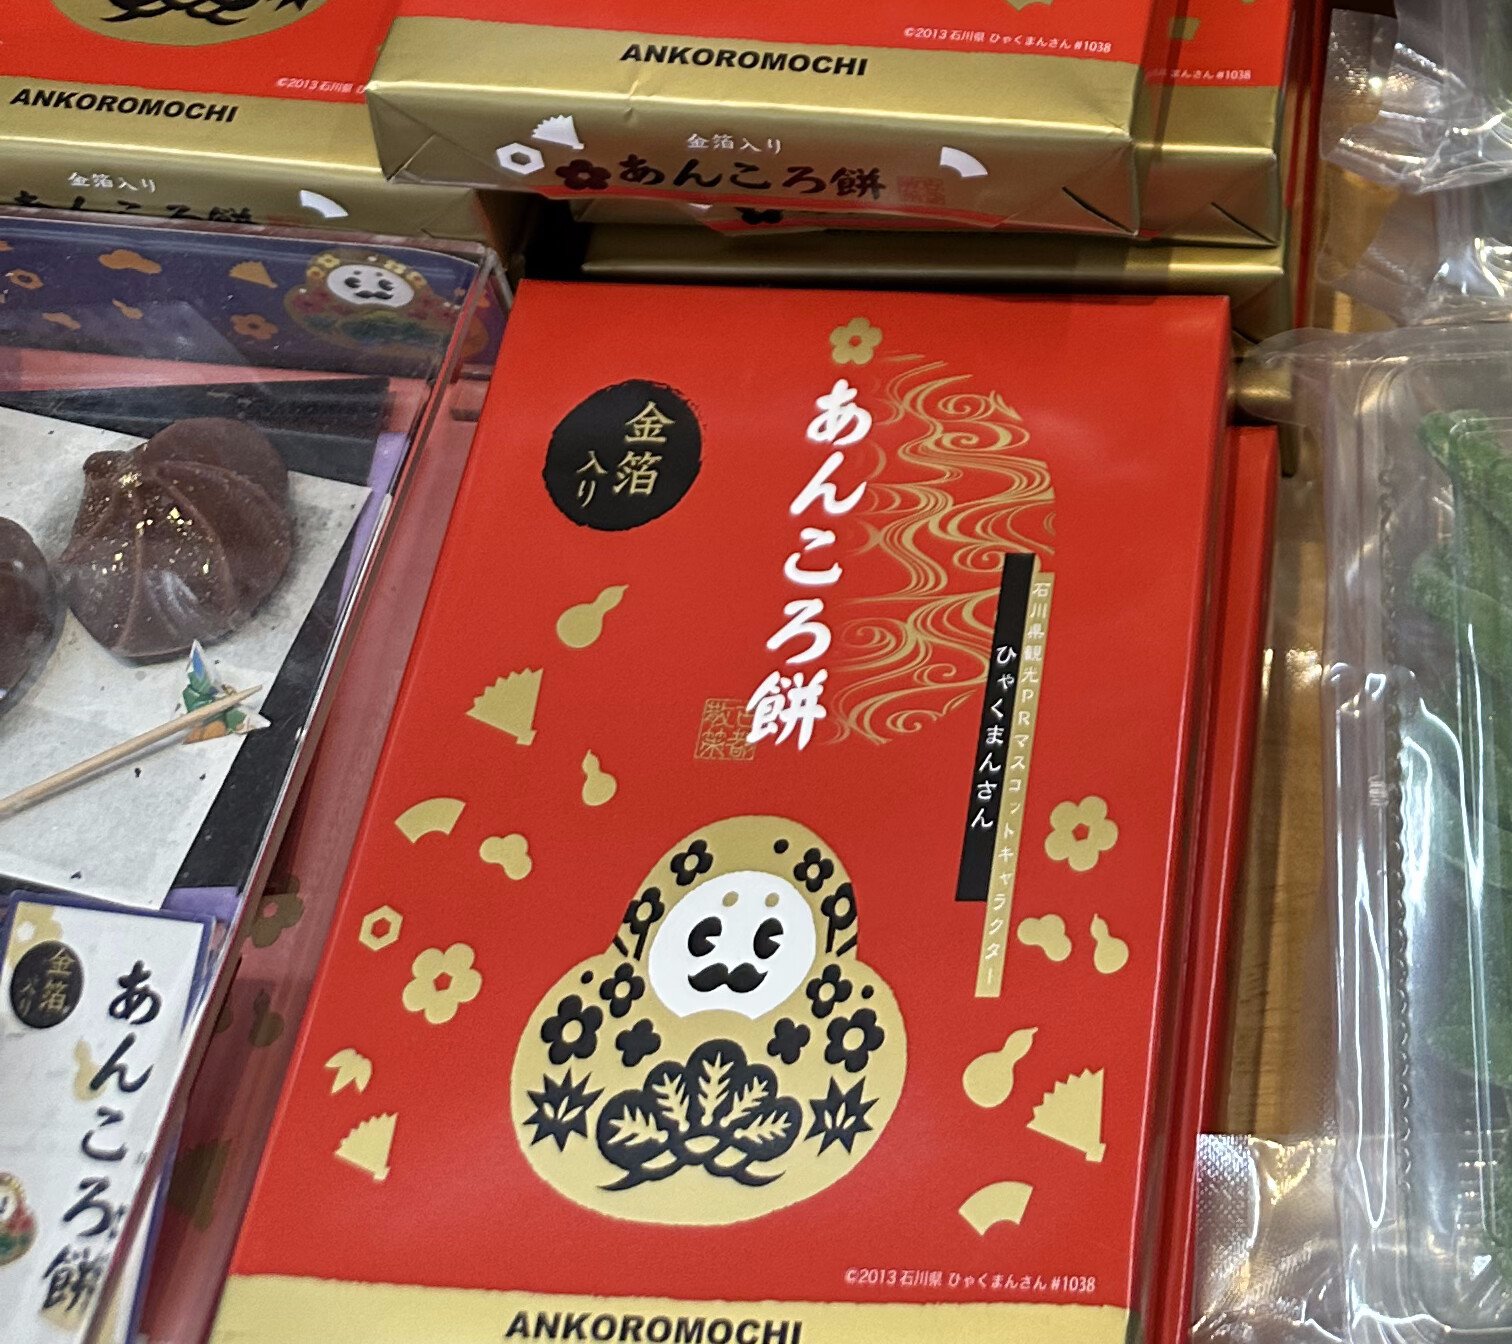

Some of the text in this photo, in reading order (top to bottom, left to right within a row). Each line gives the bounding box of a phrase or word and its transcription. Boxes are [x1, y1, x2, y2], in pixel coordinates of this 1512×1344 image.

[620, 43, 868, 78] ANKOROMOCHI
[10, 88, 239, 123] ANKOROMOCHI
[686, 132, 784, 157] 金箔入り
[67, 171, 156, 194] 金箔入り
[618, 154, 885, 200] あんころ餅
[745, 378, 873, 752] あんころ餅
[971, 645, 1017, 830] ひゃくまんさん
[503, 1311, 803, 1344] ANKOROMOCHI
